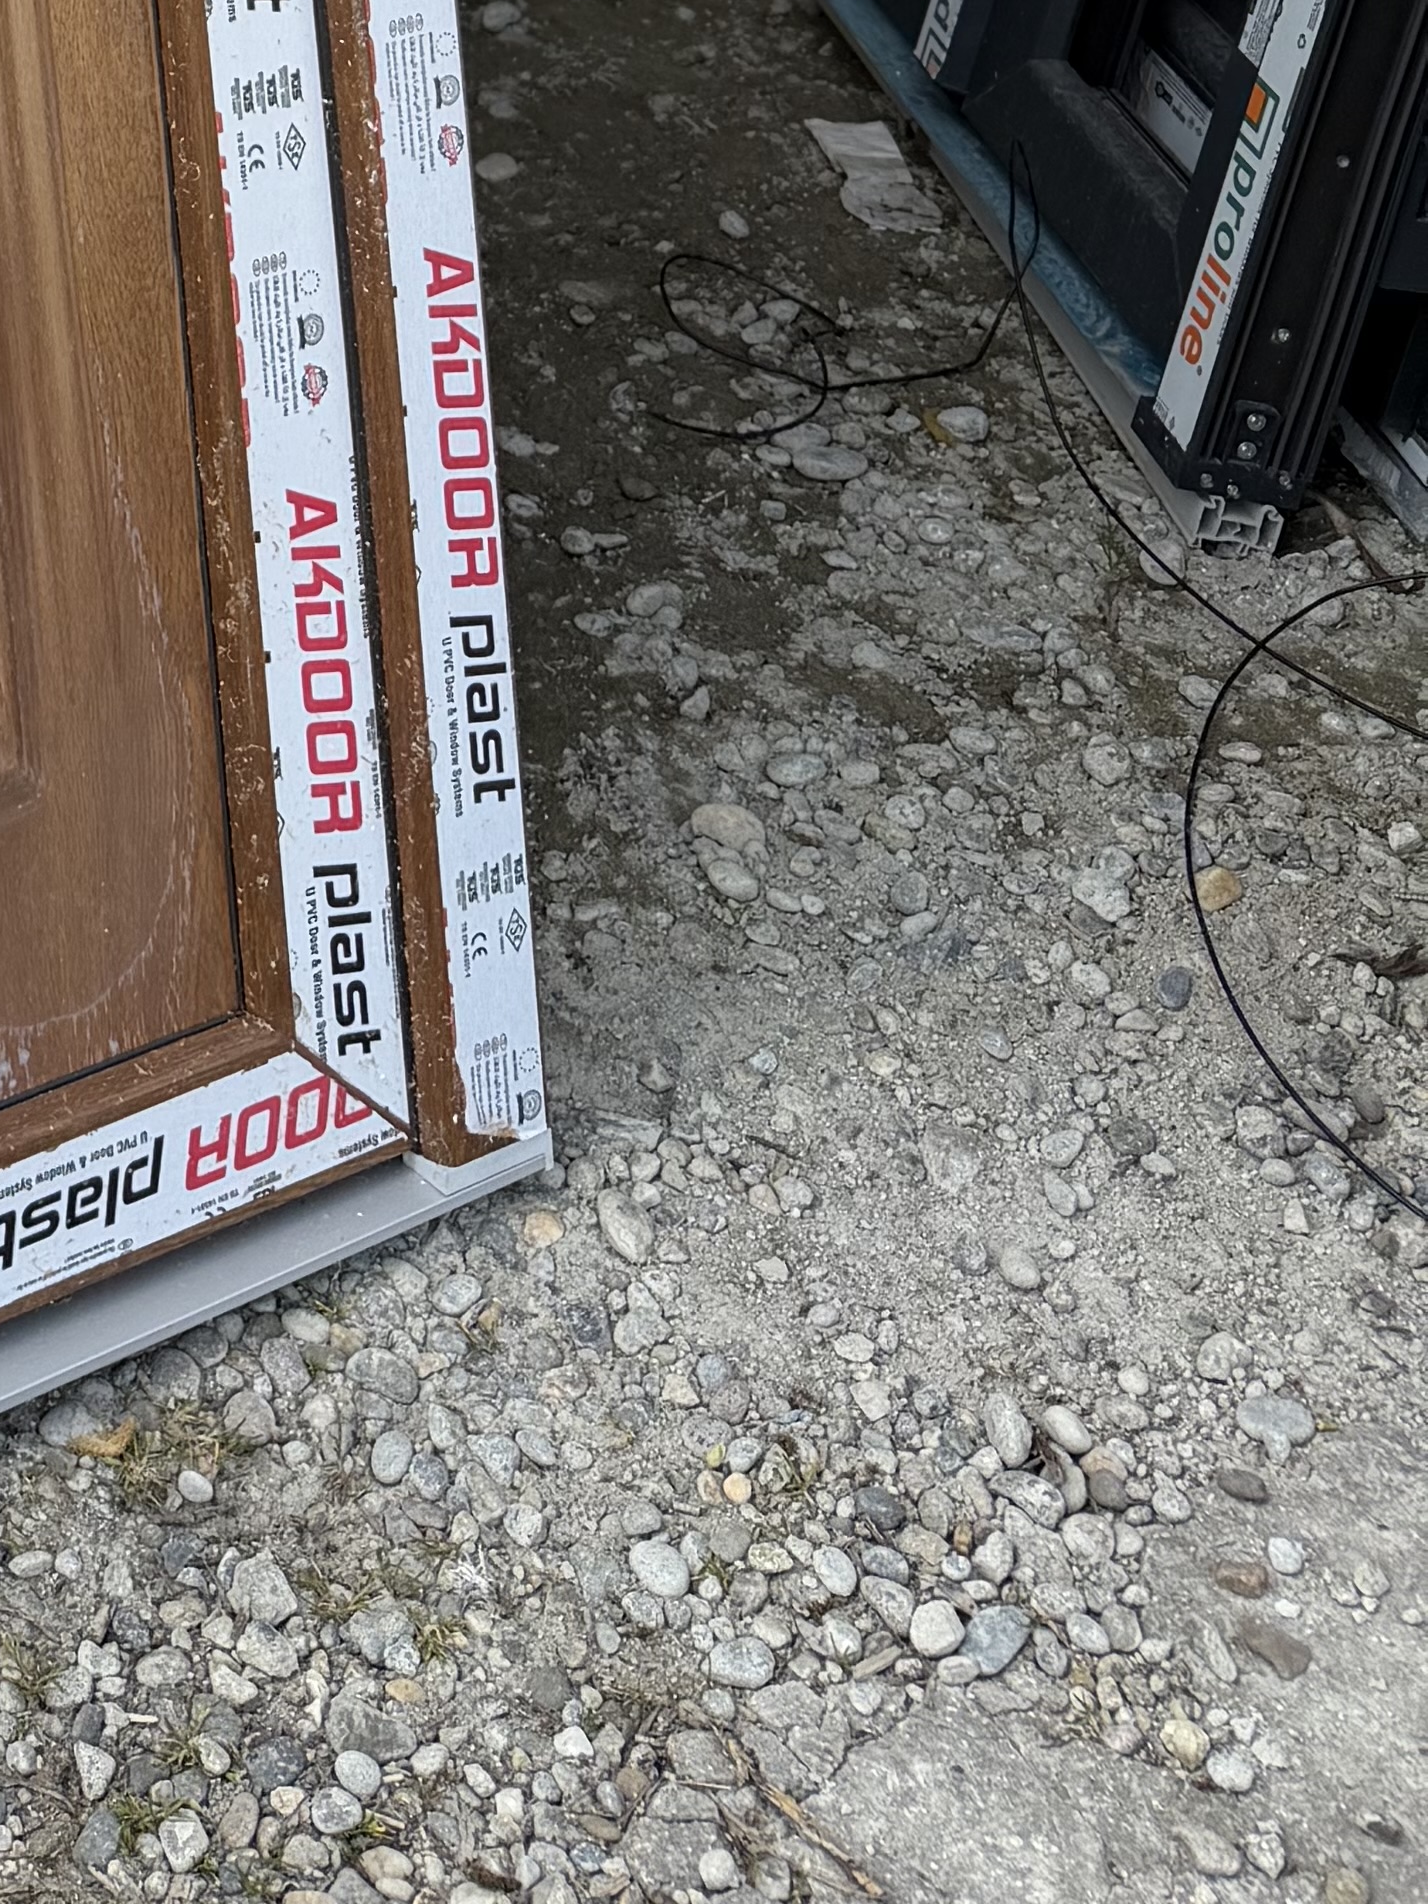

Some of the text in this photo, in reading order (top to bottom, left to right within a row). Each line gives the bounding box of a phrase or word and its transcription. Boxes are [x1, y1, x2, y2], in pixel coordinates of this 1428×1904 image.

[423, 249, 516, 804] AKDOOR plast
[1180, 170, 1256, 366] proline
[285, 489, 381, 1058] AKDOOR plast
